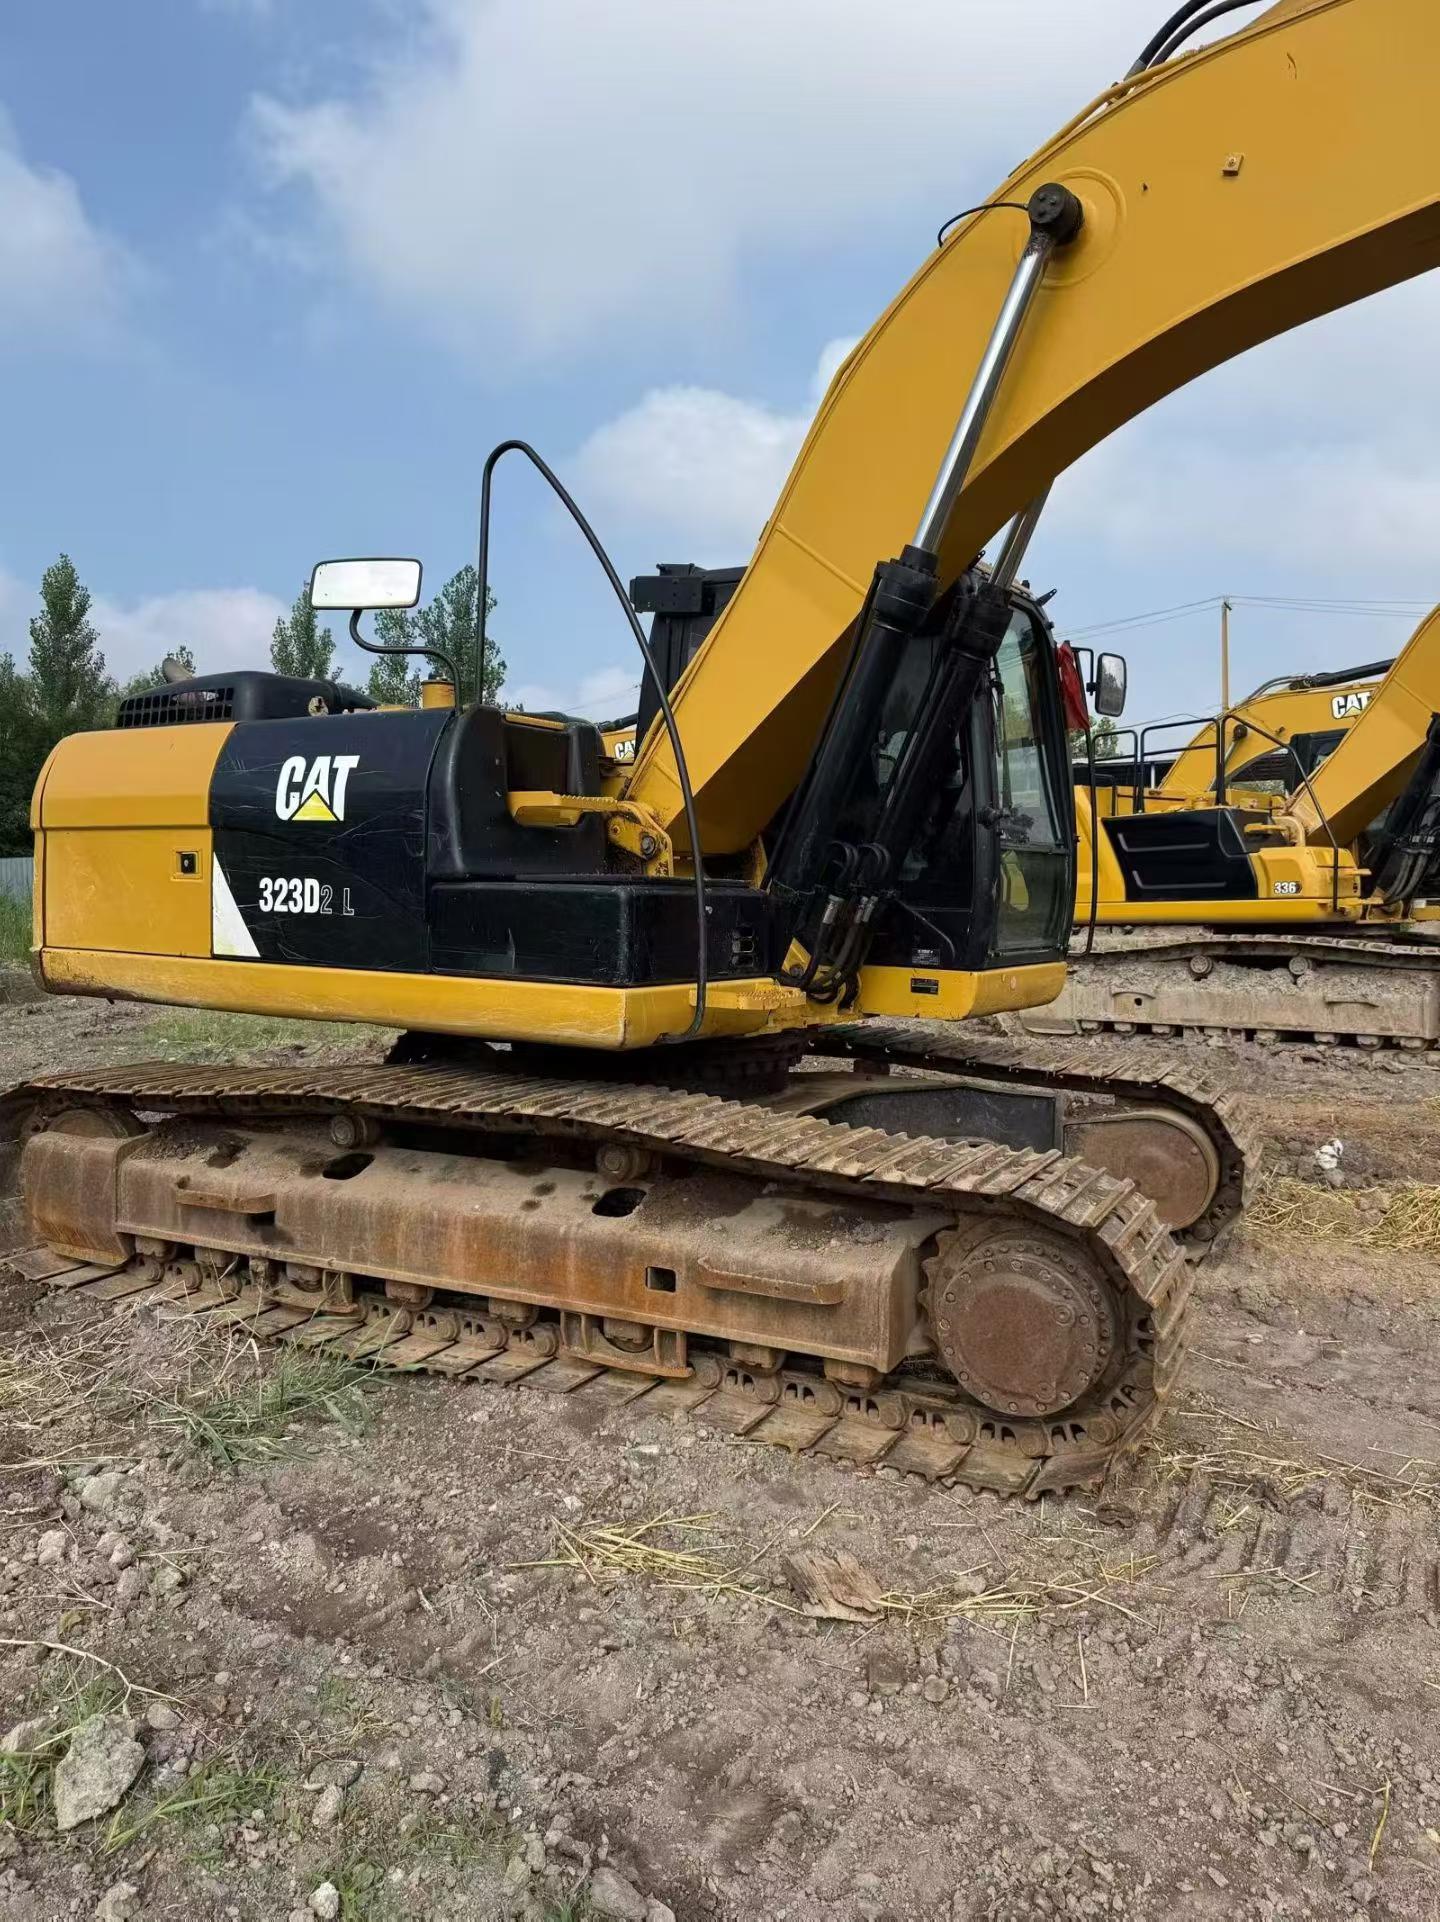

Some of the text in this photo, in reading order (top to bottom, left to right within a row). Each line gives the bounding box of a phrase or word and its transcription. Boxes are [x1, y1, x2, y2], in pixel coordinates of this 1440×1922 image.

[1331, 691, 1371, 719] CAT
[614, 740, 636, 760] CA
[275, 755, 360, 822] CAT
[343, 887, 355, 916] L
[1274, 881, 1297, 894] 336
